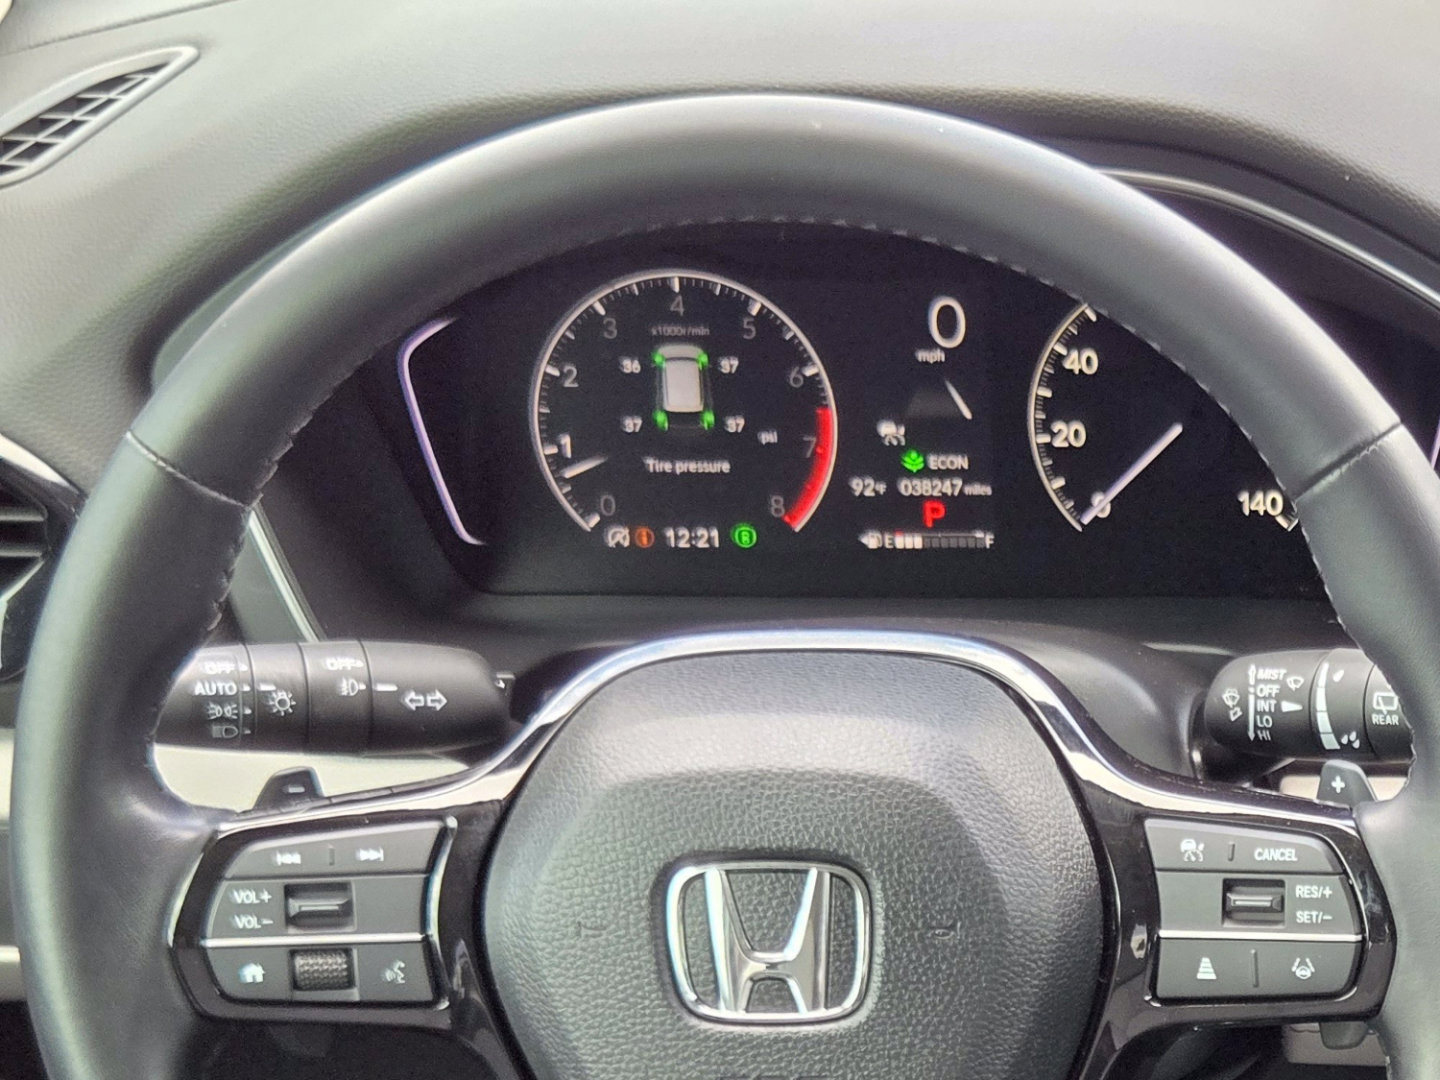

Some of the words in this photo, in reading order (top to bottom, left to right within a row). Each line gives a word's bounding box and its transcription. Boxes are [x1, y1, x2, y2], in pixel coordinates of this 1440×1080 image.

[669, 294, 685, 317] 4
[602, 317, 618, 339] 3
[742, 317, 757, 340] 5
[927, 295, 966, 349] 0
[915, 349, 946, 364] mph
[1061, 348, 1099, 375] 40
[563, 365, 579, 388] 2
[789, 366, 804, 388] 6
[559, 432, 573, 458] 1
[1049, 421, 1087, 449] 20
[802, 436, 818, 458] 7
[646, 457, 672, 473] Tire
[675, 459, 731, 475] pressure
[928, 453, 969, 471] ECON
[898, 476, 963, 497] 038247
[963, 482, 993, 496] miles
[599, 493, 616, 516] 0
[768, 494, 786, 518] 8
[922, 500, 946, 529] P
[1237, 490, 1284, 517] 140
[663, 527, 720, 549] 12:21
[1256, 668, 1287, 681] MIST
[193, 680, 238, 696] AUTO
[1256, 684, 1280, 698] OFF
[1256, 700, 1277, 713] INT
[1256, 715, 1273, 728] LO
[1371, 713, 1400, 726] REAR
[1257, 729, 1272, 741] HI
[1253, 847, 1299, 862] CANCEL
